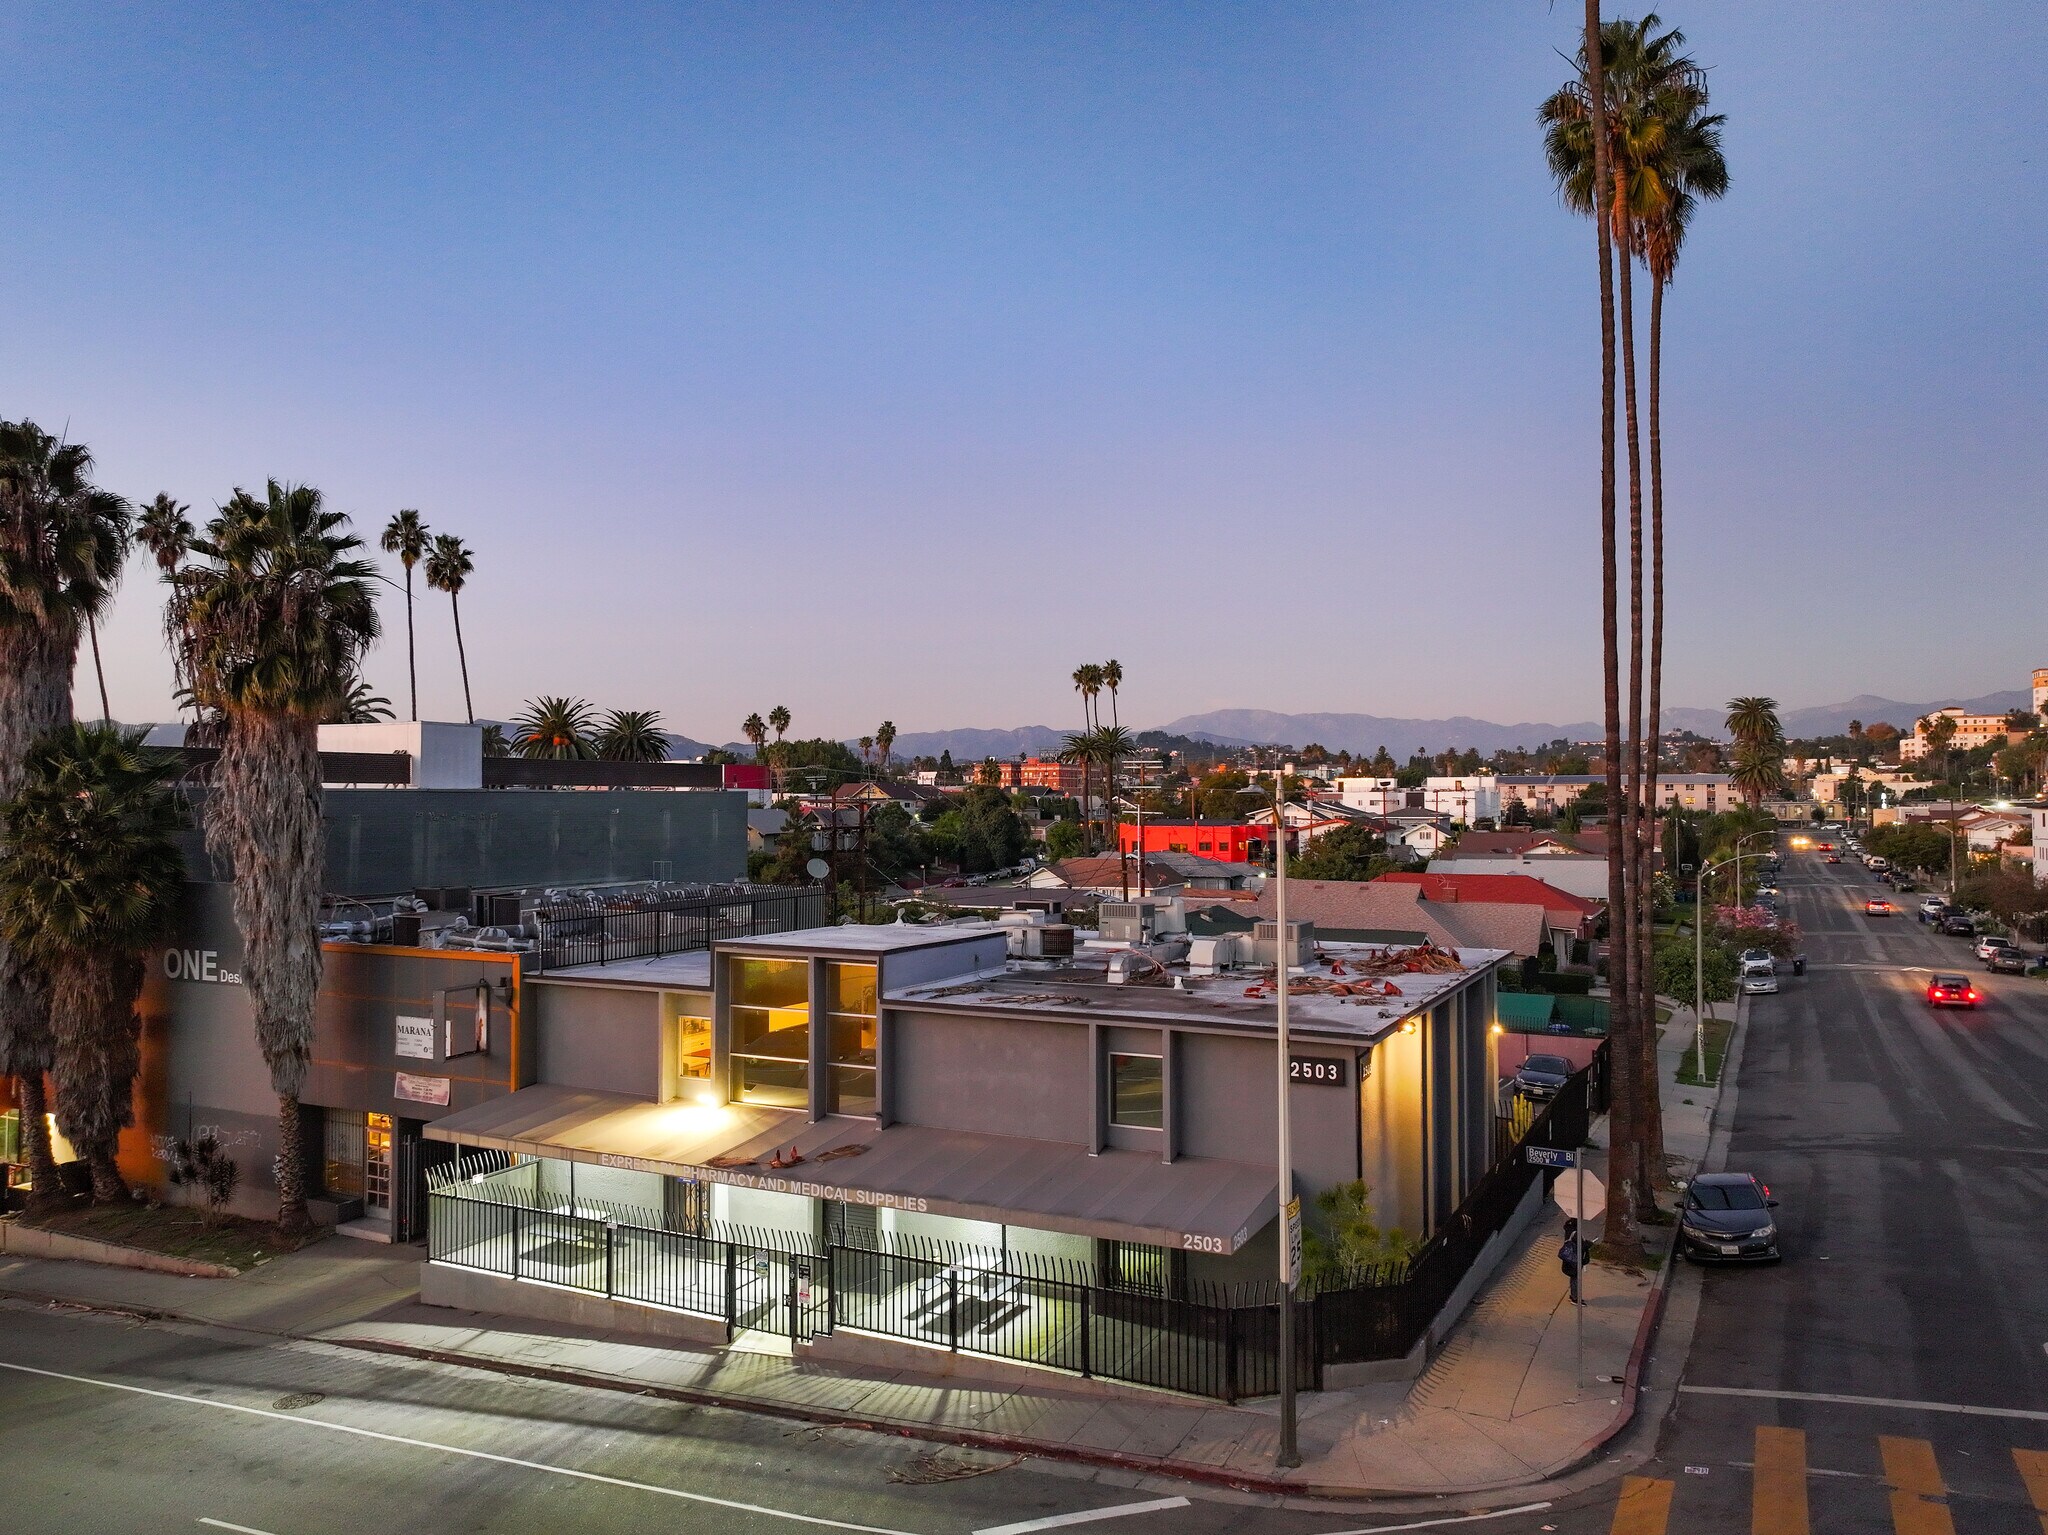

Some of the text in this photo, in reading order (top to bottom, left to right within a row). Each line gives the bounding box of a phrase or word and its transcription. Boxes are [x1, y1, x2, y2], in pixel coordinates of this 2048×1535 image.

[163, 947, 218, 982] ONE
[397, 1024, 433, 1037] MARANA
[1290, 1061, 1337, 1080] 2503
[1528, 1147, 1558, 1162] Beverly
[601, 1153, 656, 1173] EXPRESS
[683, 1165, 756, 1188] PHARMACY
[758, 1176, 787, 1192] AND
[790, 1180, 853, 1202] MEDICAL
[856, 1189, 928, 1212] SUPPLIES
[1183, 1233, 1223, 1253] 2503
[1290, 1239, 1302, 1267] 25
